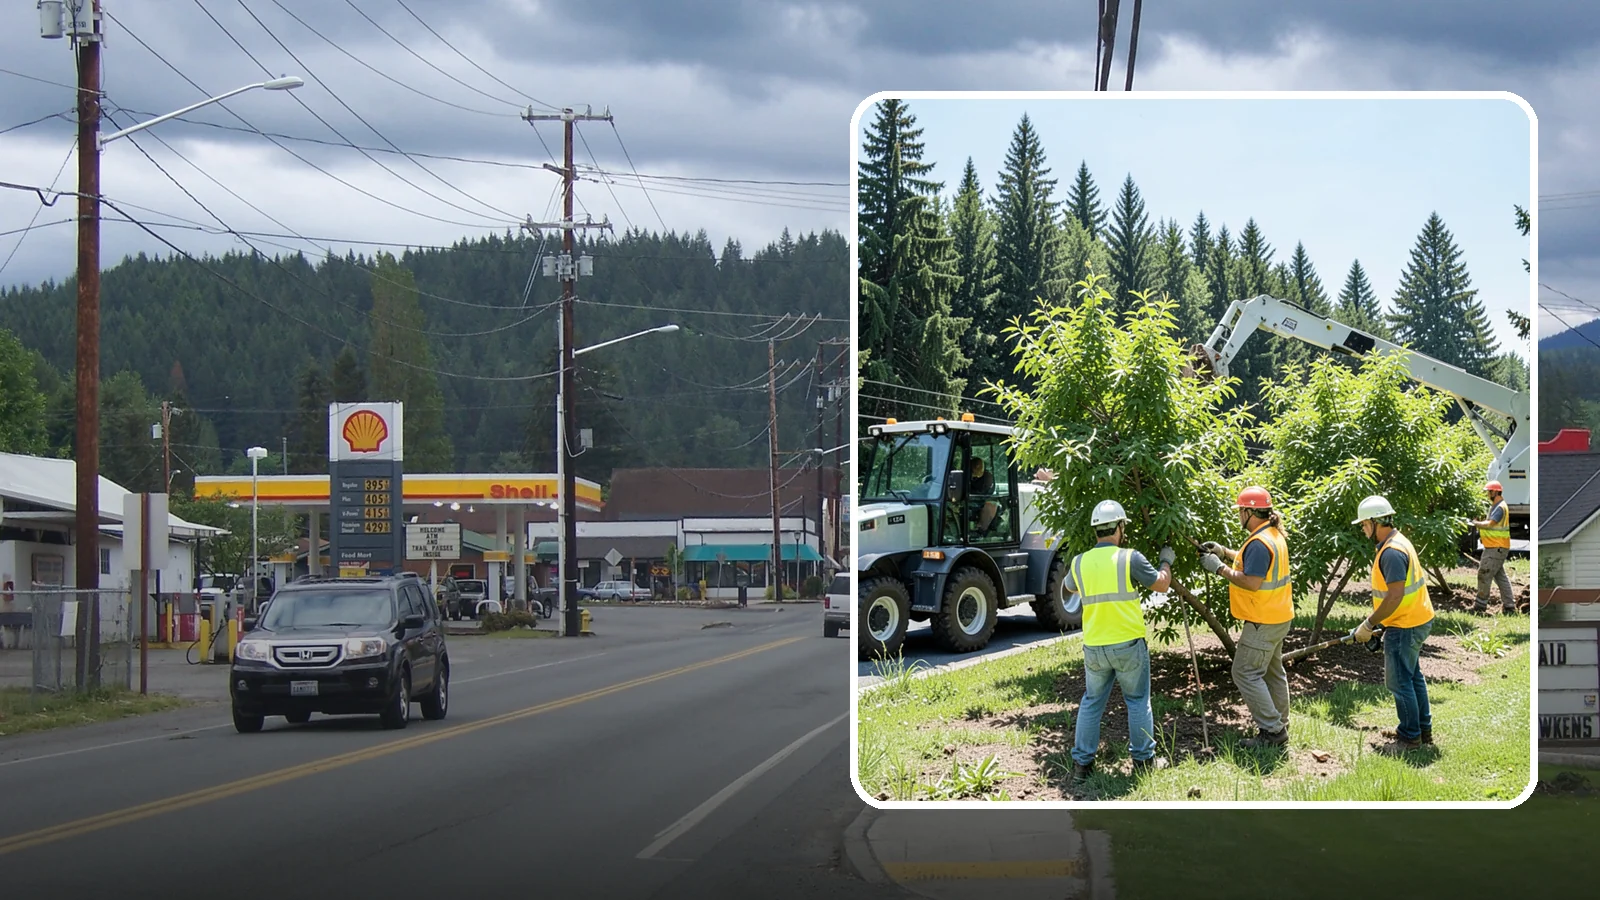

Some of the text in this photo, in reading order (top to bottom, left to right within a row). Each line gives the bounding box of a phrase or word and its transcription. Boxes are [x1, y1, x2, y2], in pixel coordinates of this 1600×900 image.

[366, 480, 383, 490] 395
[490, 484, 547, 499] Shell
[366, 494, 383, 504] 405
[366, 508, 383, 518] 415
[366, 522, 383, 532] 429
